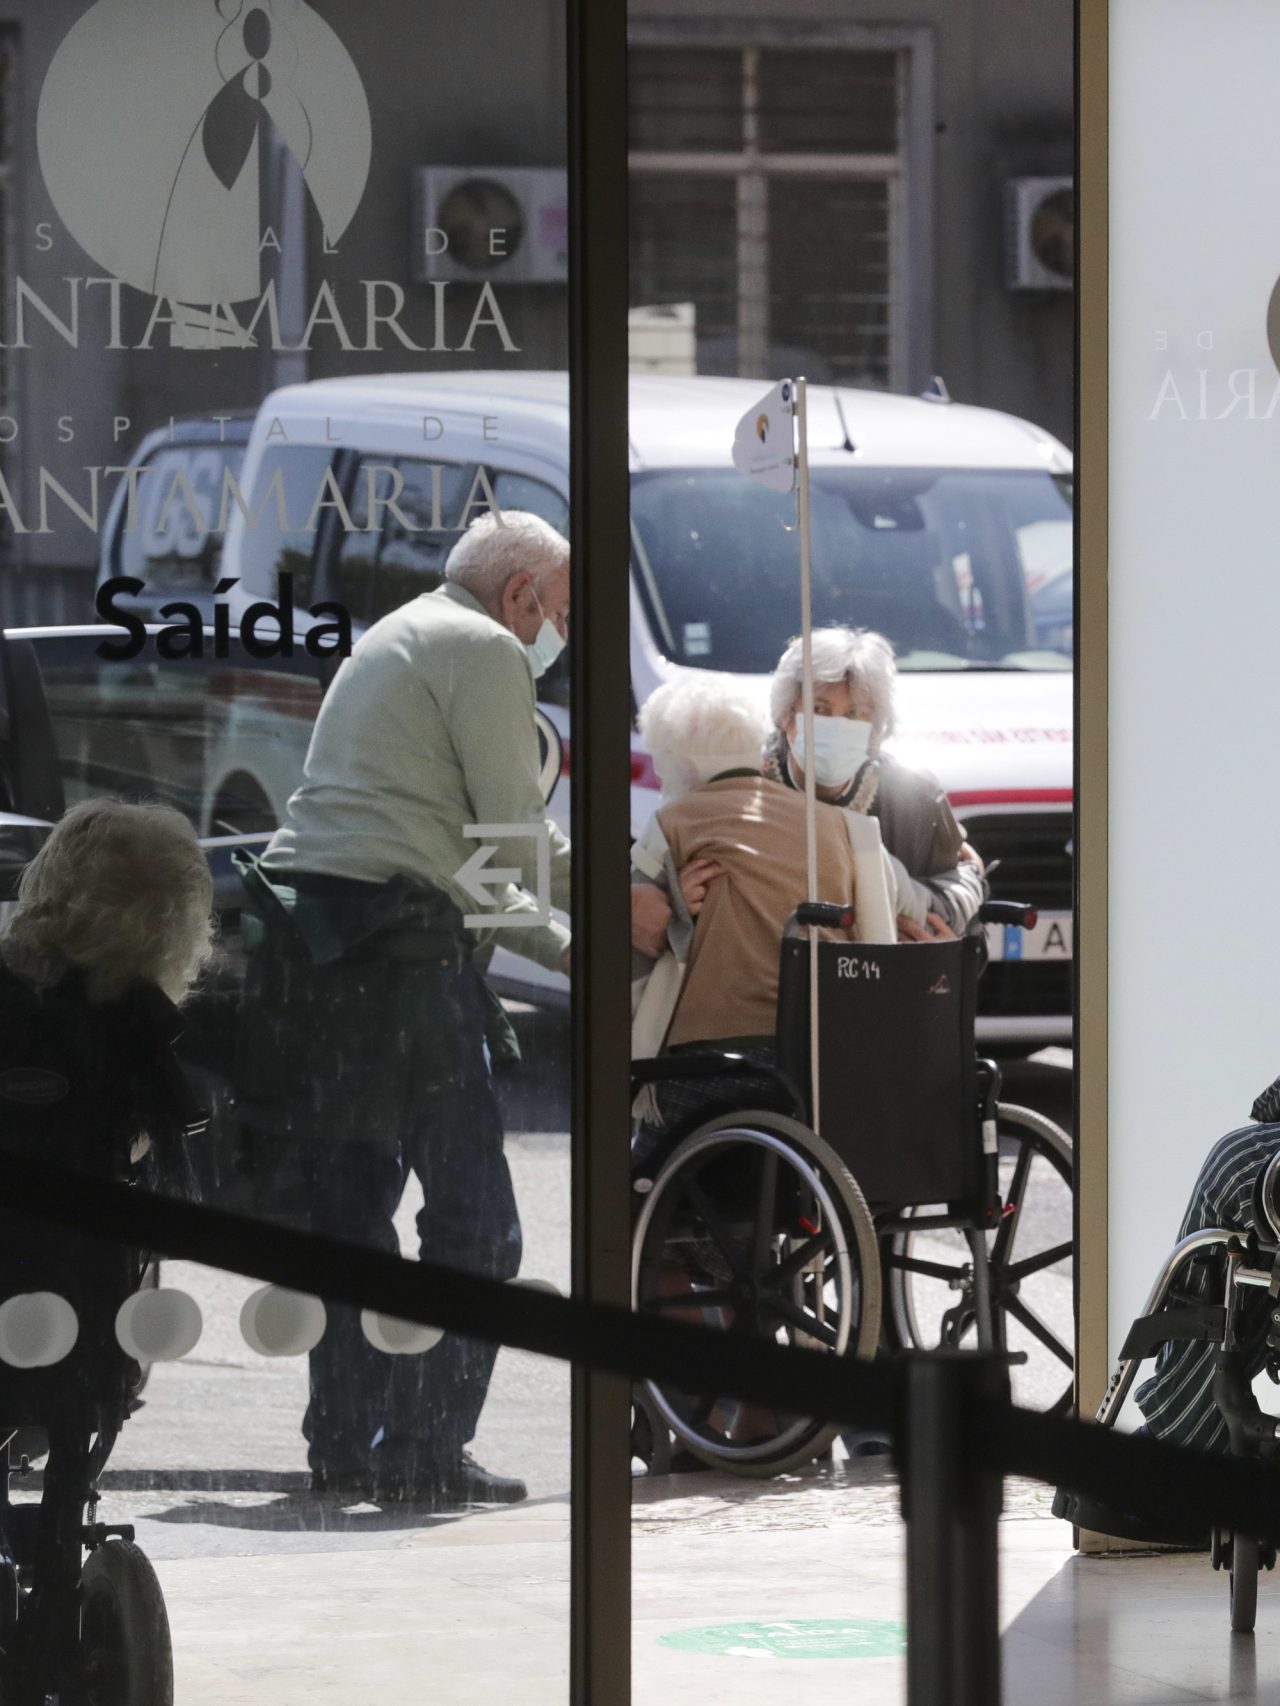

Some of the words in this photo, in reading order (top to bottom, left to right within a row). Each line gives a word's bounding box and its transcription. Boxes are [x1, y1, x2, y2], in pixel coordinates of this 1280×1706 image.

[425, 228, 507, 256] DE
[0, 276, 521, 352] NTAMARIA
[423, 416, 499, 441] DE
[95, 572, 353, 661] Saída
[838, 956, 859, 979] RC
[862, 957, 881, 980] 14
